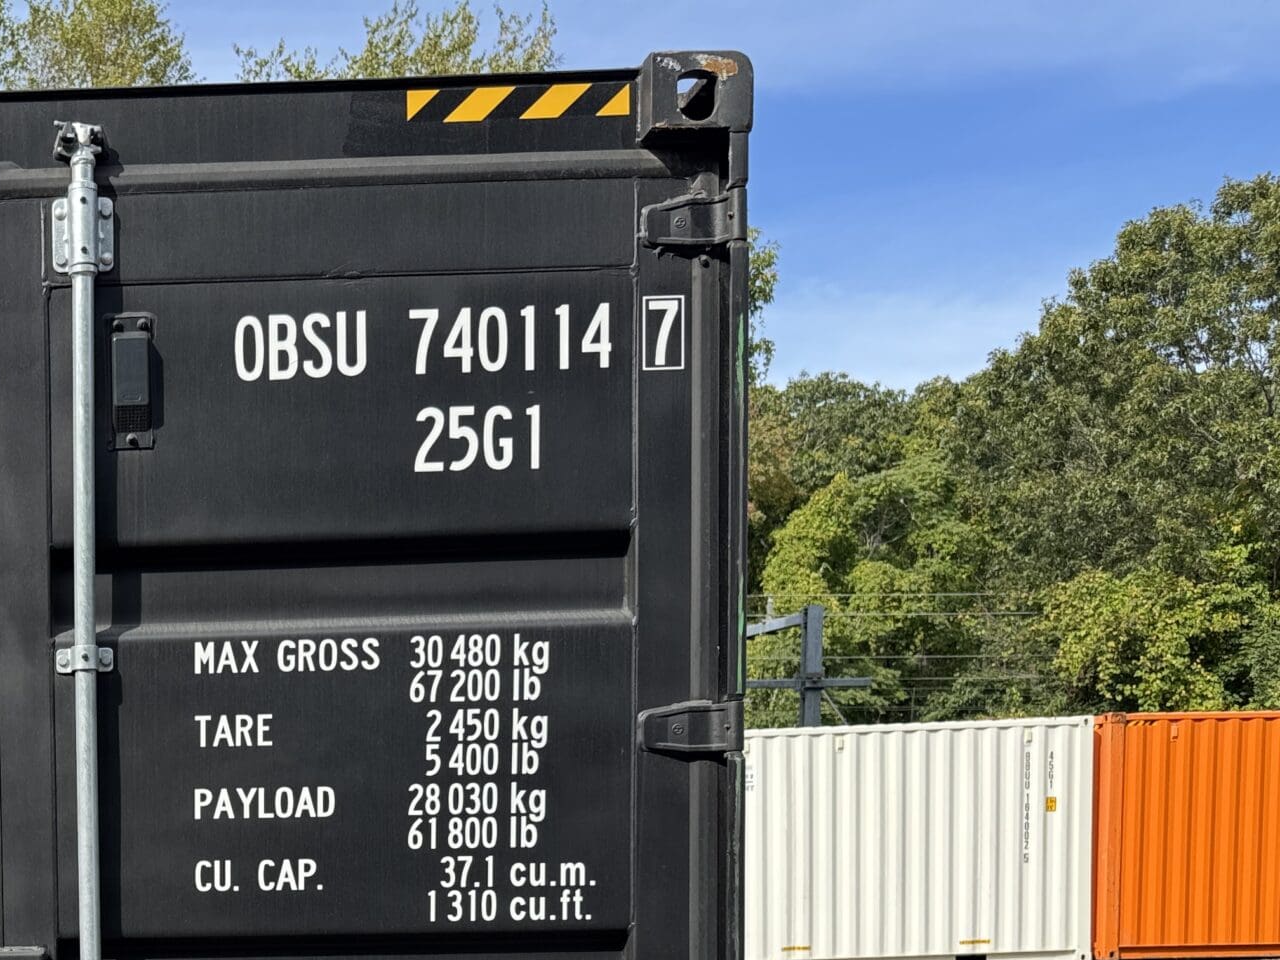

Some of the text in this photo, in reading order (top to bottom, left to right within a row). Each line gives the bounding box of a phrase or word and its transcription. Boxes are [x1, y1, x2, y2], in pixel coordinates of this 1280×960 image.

[234, 299, 679, 382] OBSU 740114 7
[414, 404, 540, 473] 25G1
[194, 637, 380, 675] MAX GROSS
[513, 633, 550, 674] kg
[512, 669, 541, 701] lb
[194, 713, 273, 748] TARE
[511, 708, 549, 748] kg
[511, 743, 539, 775] lb
[194, 786, 336, 820] PAYLOAD
[510, 782, 546, 822] kg
[510, 817, 538, 849] lb
[194, 858, 323, 892] CU. CAP.
[440, 856, 596, 888] 37.1 cu.m.
[509, 889, 592, 921] cu.ft.
